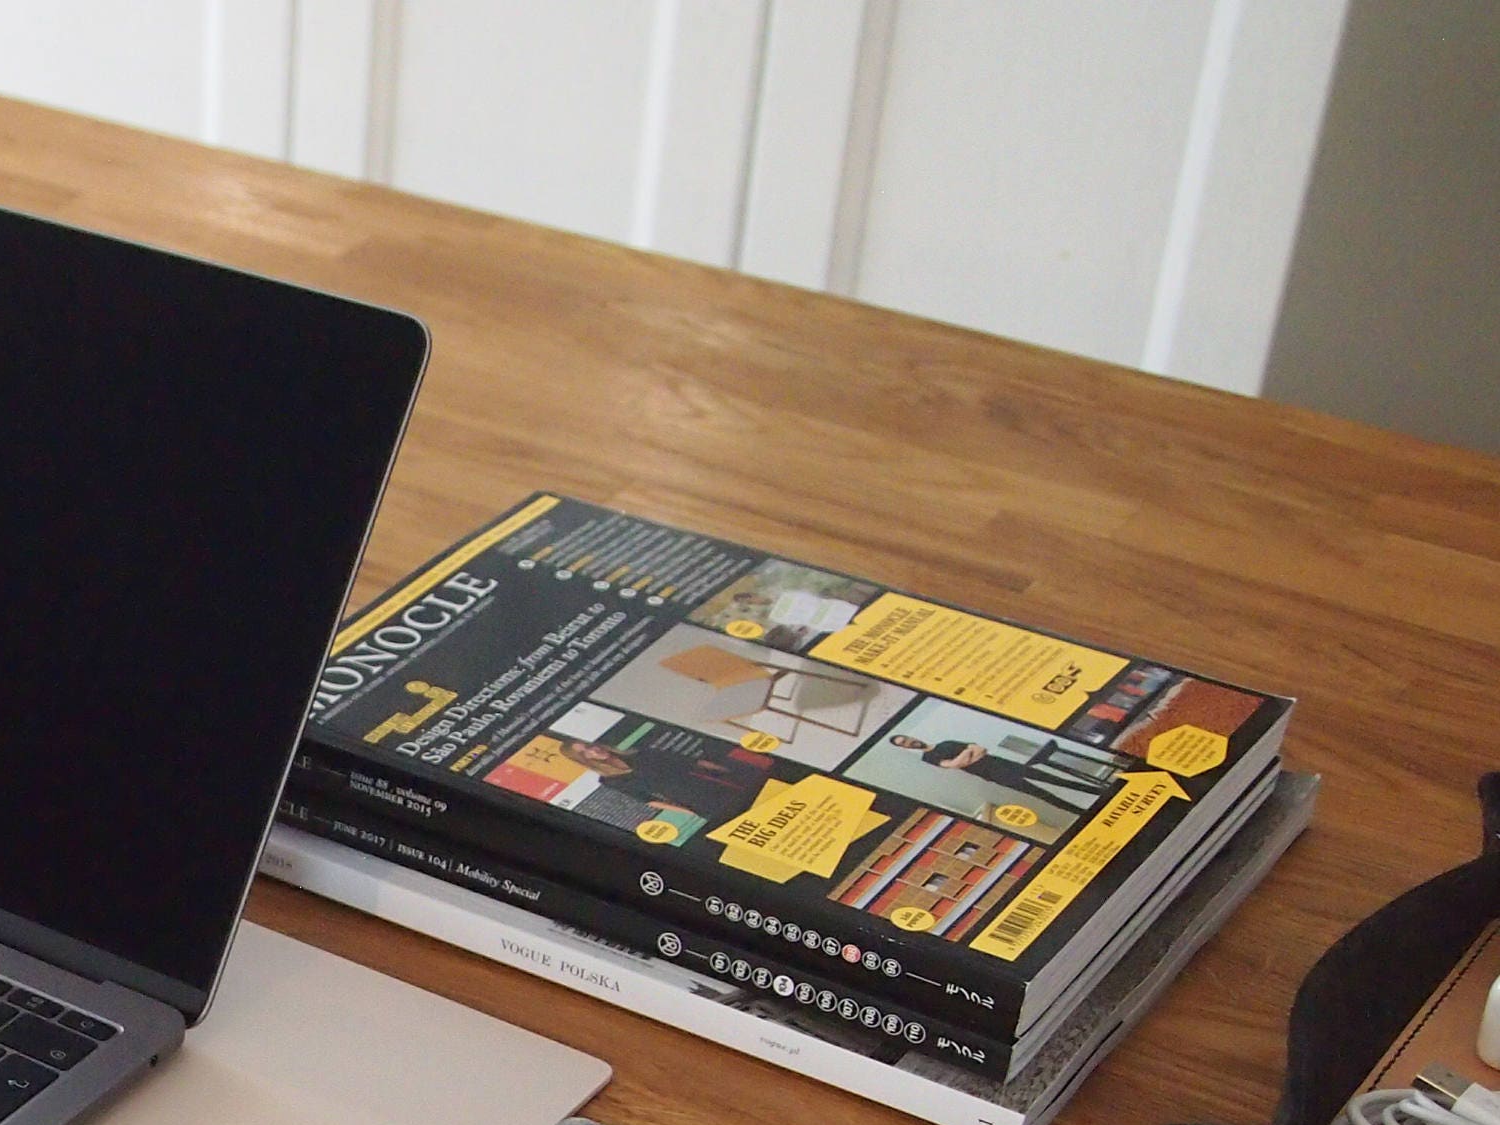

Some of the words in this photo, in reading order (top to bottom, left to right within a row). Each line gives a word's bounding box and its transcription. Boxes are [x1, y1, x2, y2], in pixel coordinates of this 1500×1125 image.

[566, 611, 627, 650] Toronto
[561, 644, 579, 661] to
[396, 719, 456, 756] Design
[443, 665, 526, 721] Directions:
[517, 643, 554, 670] from
[542, 612, 594, 646] Beirut
[587, 602, 606, 615] to
[489, 659, 568, 712] Rovaniemi
[446, 712, 504, 745] Paulo,
[421, 742, 457, 764] São
[406, 799, 433, 818] 2015
[1101, 791, 1141, 828] BAVARIA
[1131, 783, 1167, 815] SURVEY
[727, 819, 761, 841] THE
[747, 829, 777, 849] BIG
[766, 801, 807, 830] IDEAS
[360, 829, 387, 848] 2017
[397, 843, 425, 861] ISSUE
[428, 853, 448, 871] 104
[455, 862, 500, 888] Mobility
[501, 878, 542, 902] Special
[500, 937, 551, 967] VOGUE
[560, 960, 621, 992] POLSKA
